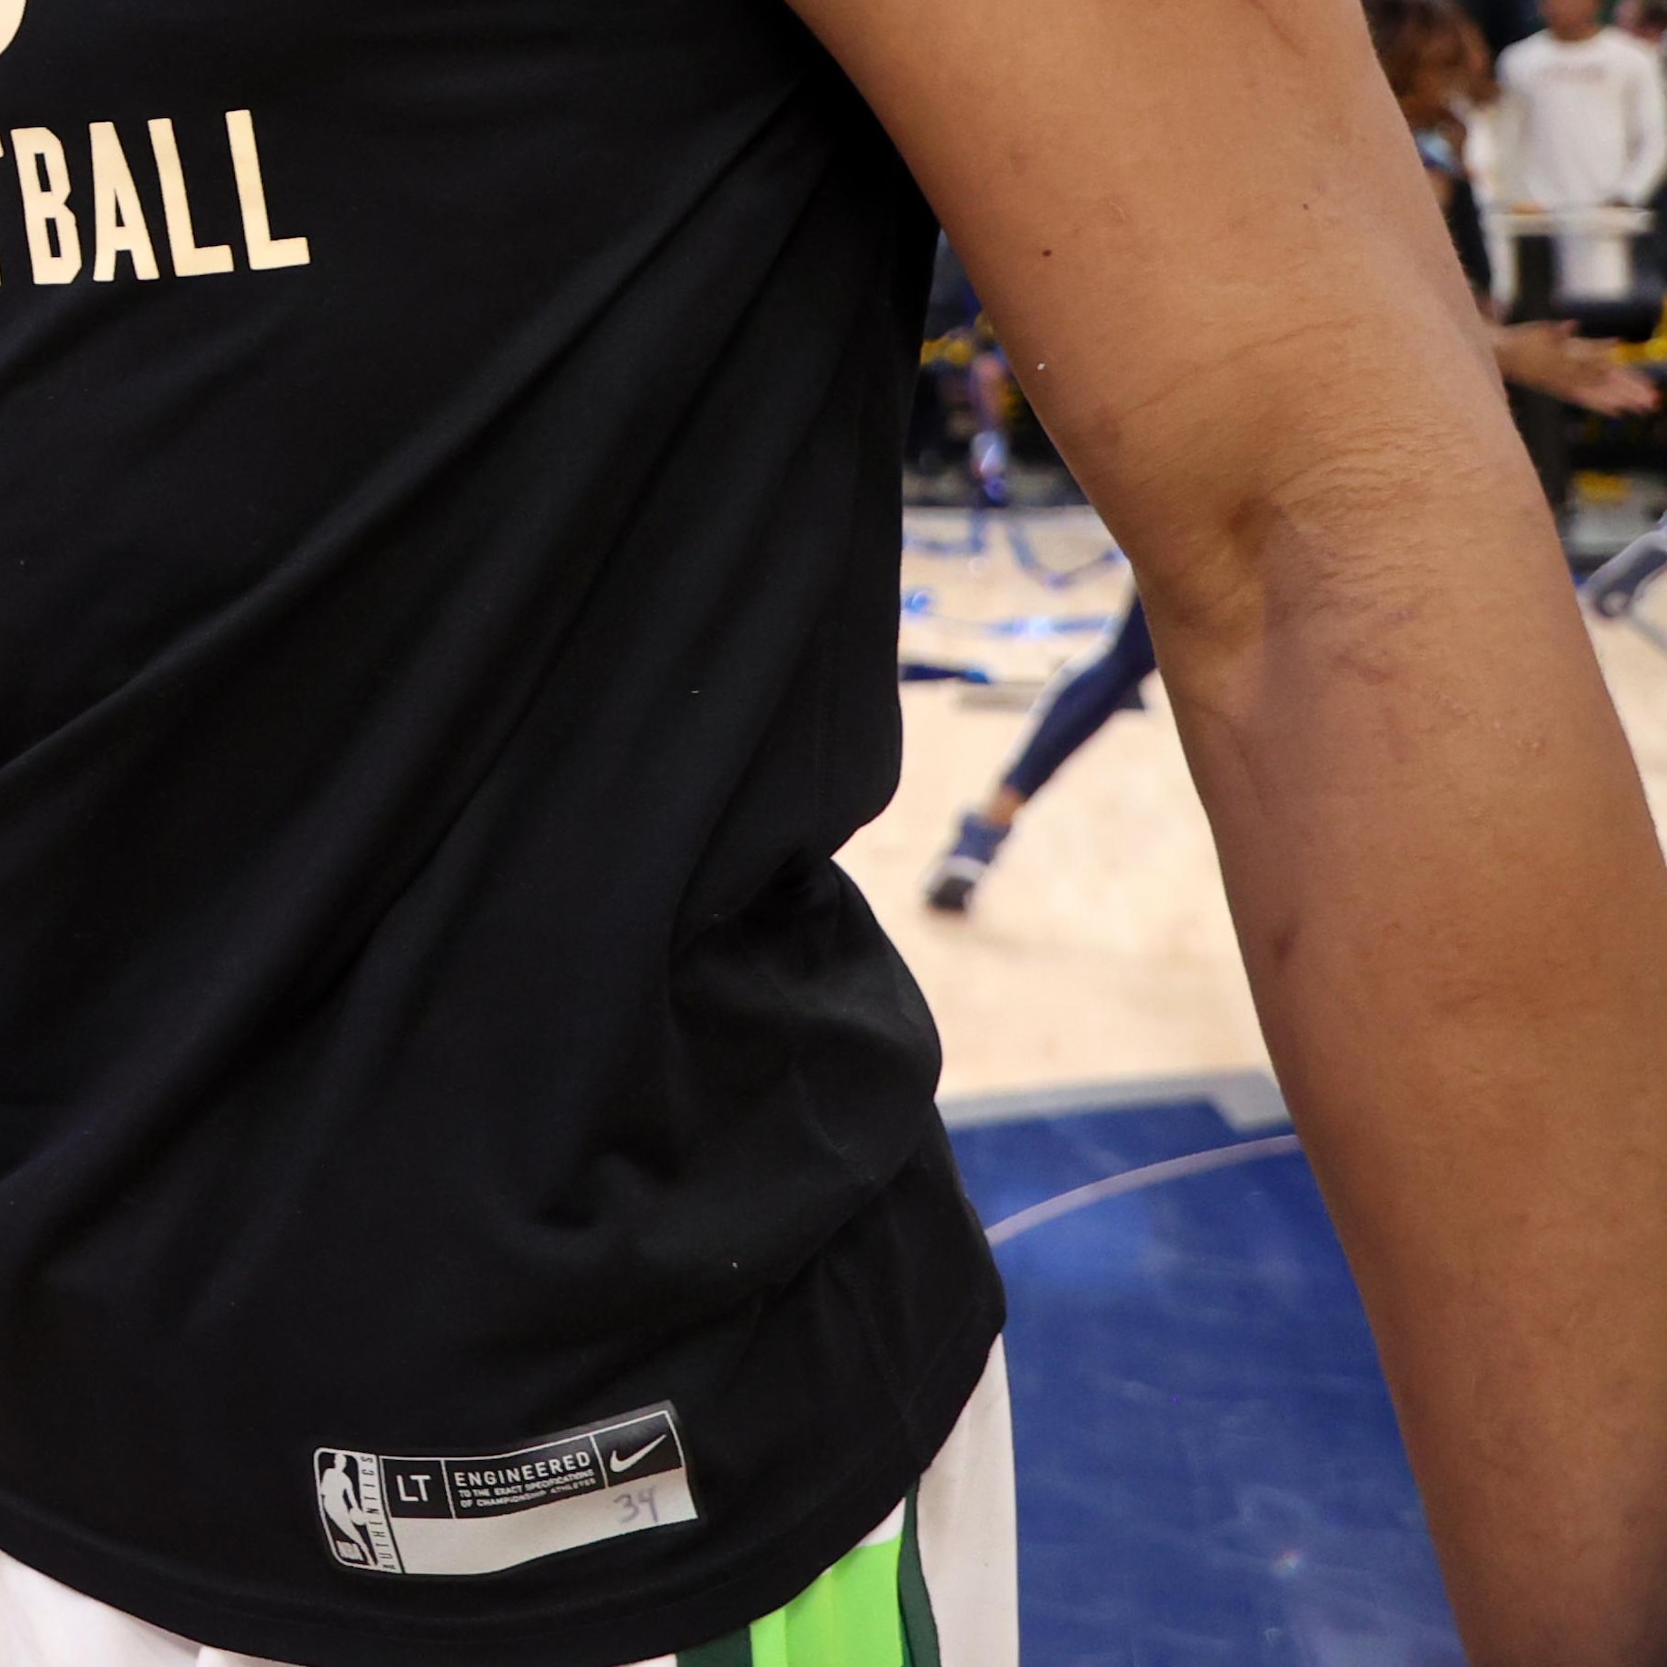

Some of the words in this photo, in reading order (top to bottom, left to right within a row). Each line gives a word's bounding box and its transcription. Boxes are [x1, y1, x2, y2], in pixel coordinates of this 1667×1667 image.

[453, 1451, 591, 1487] ENGINEERED
[396, 1474, 432, 1502] LT
[473, 1487, 491, 1497] THE
[494, 1484, 523, 1497] EXACT
[360, 1456, 396, 1570] AUTHENTICS
[460, 1499, 473, 1509] OF
